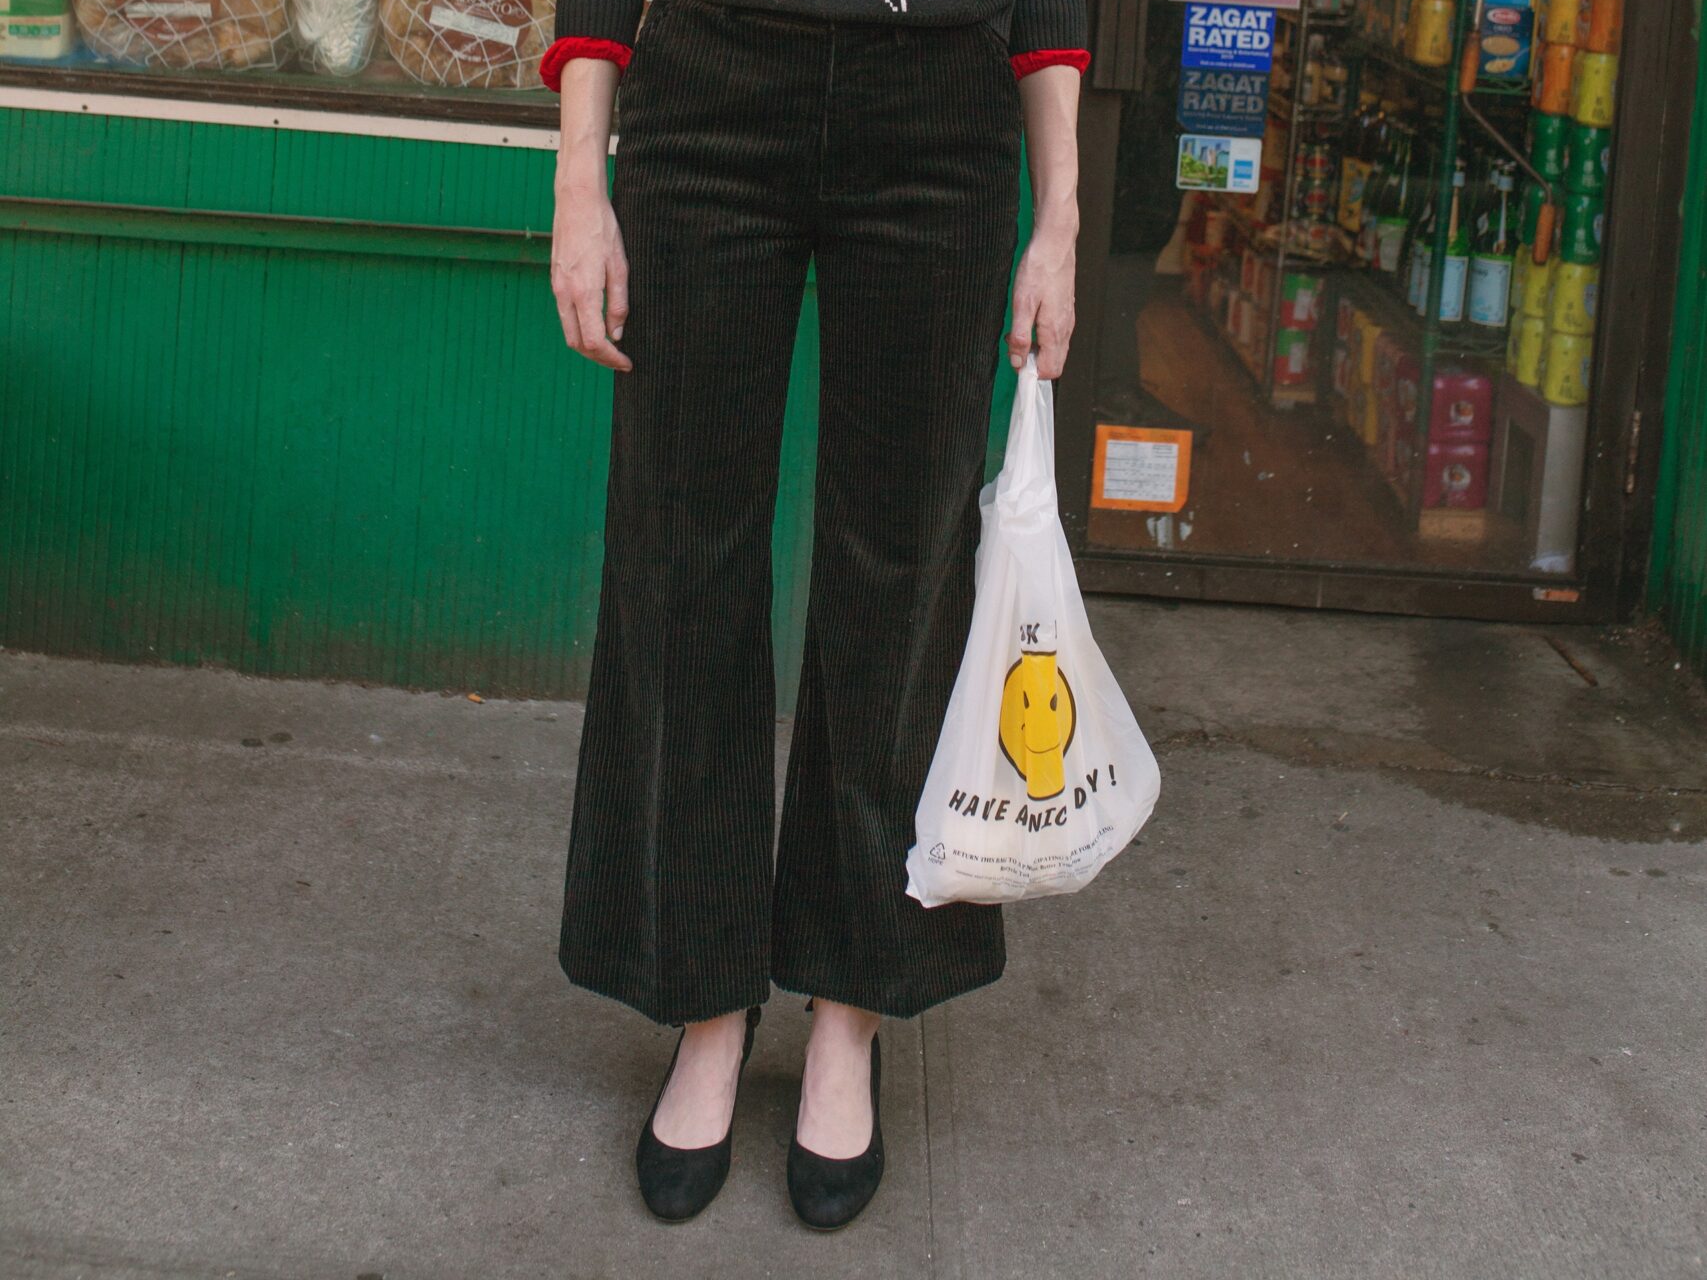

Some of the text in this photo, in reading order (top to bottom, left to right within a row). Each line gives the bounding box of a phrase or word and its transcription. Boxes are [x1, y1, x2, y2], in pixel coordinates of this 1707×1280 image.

[1190, 6, 1272, 29] ZAGAT
[1188, 26, 1270, 51] RATED
[1184, 71, 1266, 94] ZAGAT
[1183, 92, 1264, 115] RATED
[949, 789, 1010, 821] HAVE
[1028, 806, 1068, 832] NIC
[952, 849, 979, 862] RETURN
